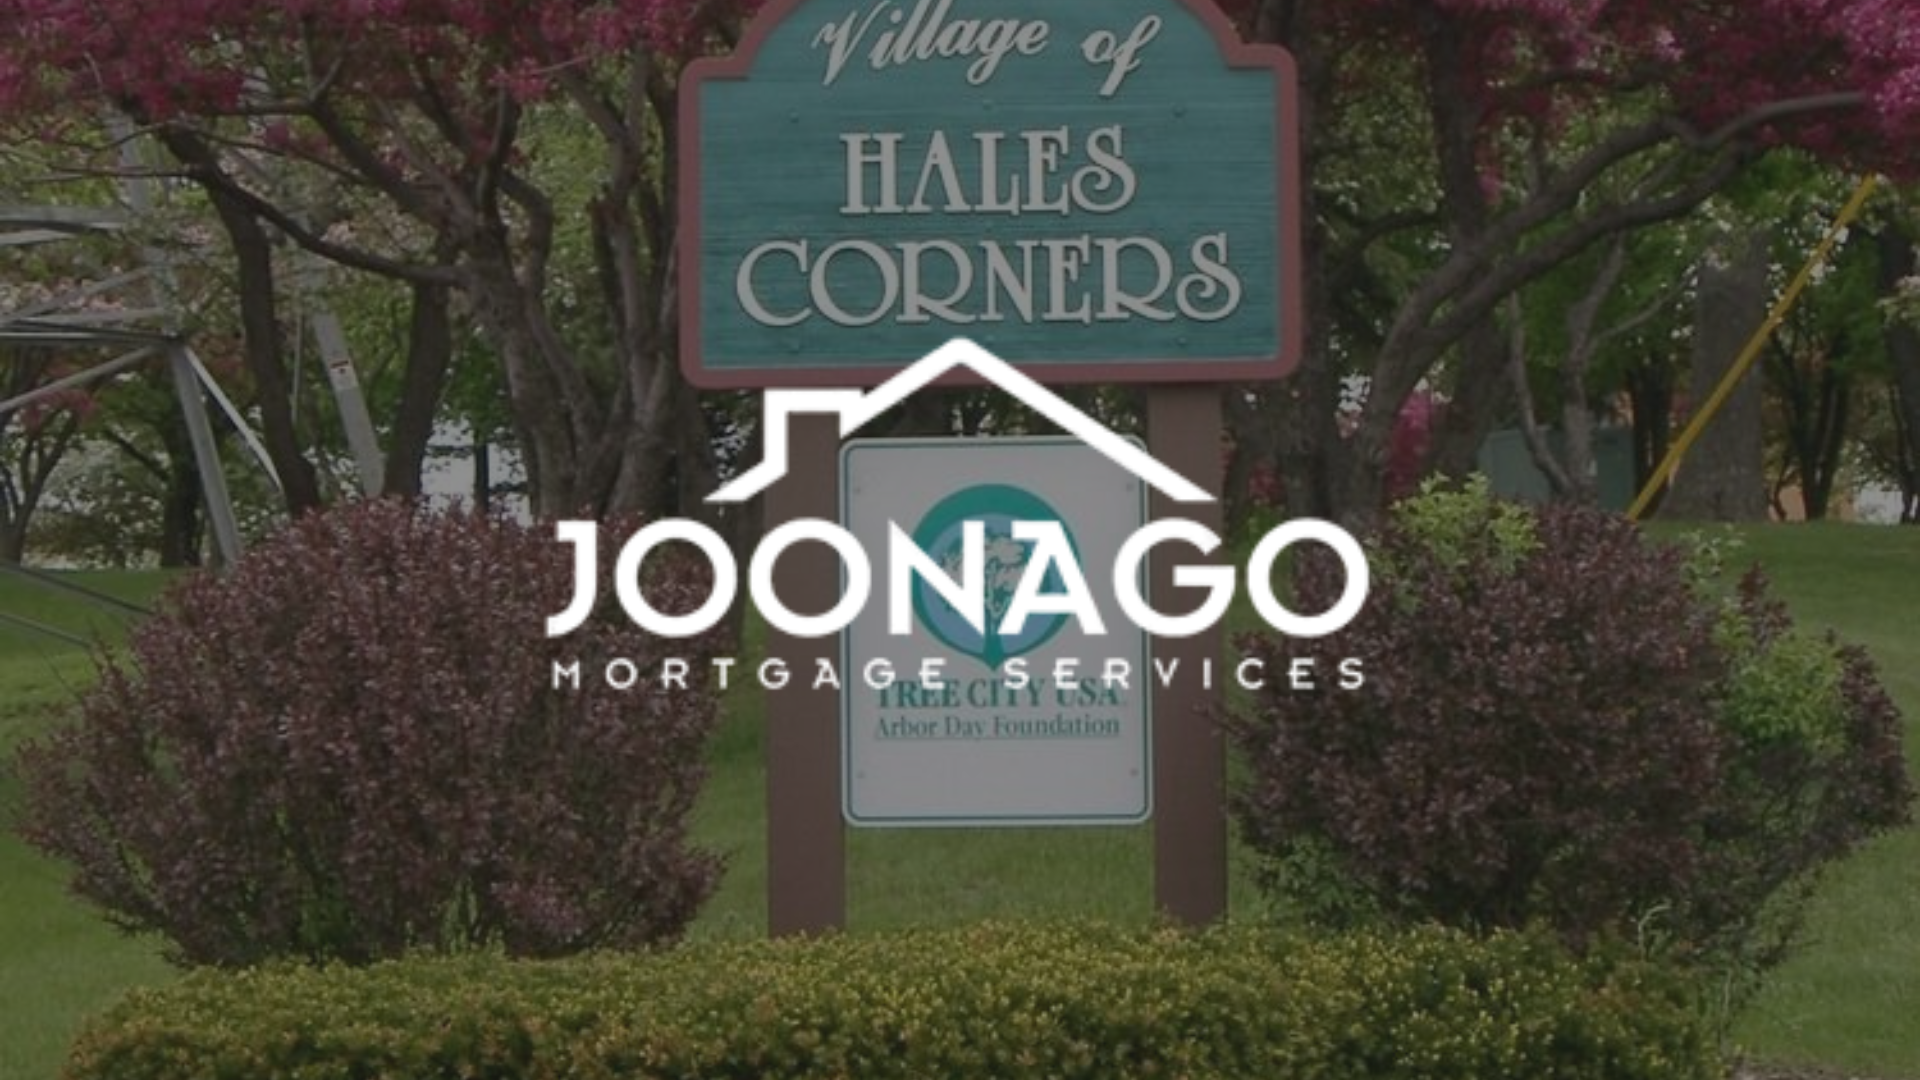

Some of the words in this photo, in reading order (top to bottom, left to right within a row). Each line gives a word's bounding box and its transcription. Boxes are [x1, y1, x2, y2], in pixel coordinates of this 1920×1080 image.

[811, 0, 1050, 86] Village
[1080, 14, 1162, 96] of
[840, 124, 1136, 215] HALES
[736, 232, 1241, 326] CORNERS
[875, 714, 939, 738] Arbor
[944, 715, 988, 741] Day
[992, 713, 1120, 738] Foundation
[876, 677, 960, 709] TREE
[966, 676, 1046, 709] CITY
[1054, 677, 1121, 709] USA
